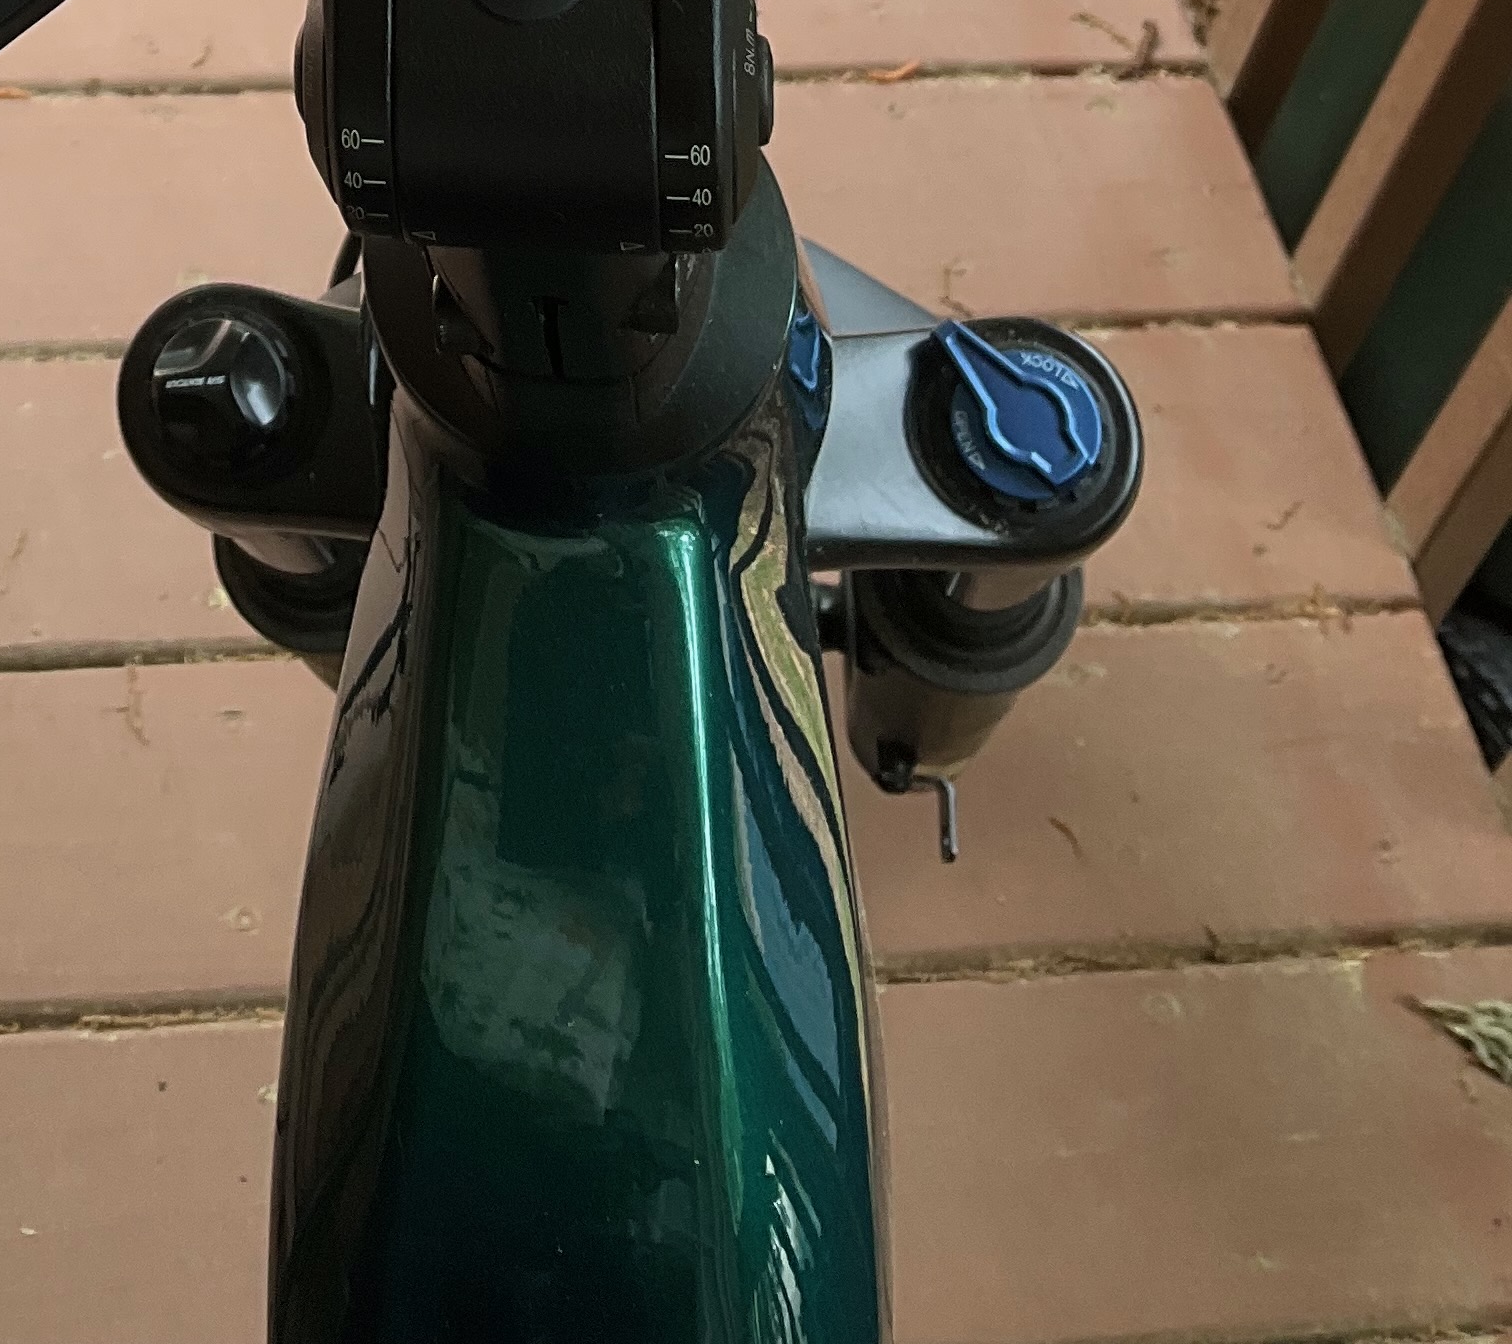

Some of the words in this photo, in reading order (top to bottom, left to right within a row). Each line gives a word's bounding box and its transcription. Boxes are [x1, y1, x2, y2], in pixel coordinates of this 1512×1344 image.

[341, 128, 361, 150] 60
[689, 146, 711, 166] 60
[343, 171, 363, 190] 40
[691, 188, 712, 207] 40
[693, 222, 714, 238] 20
